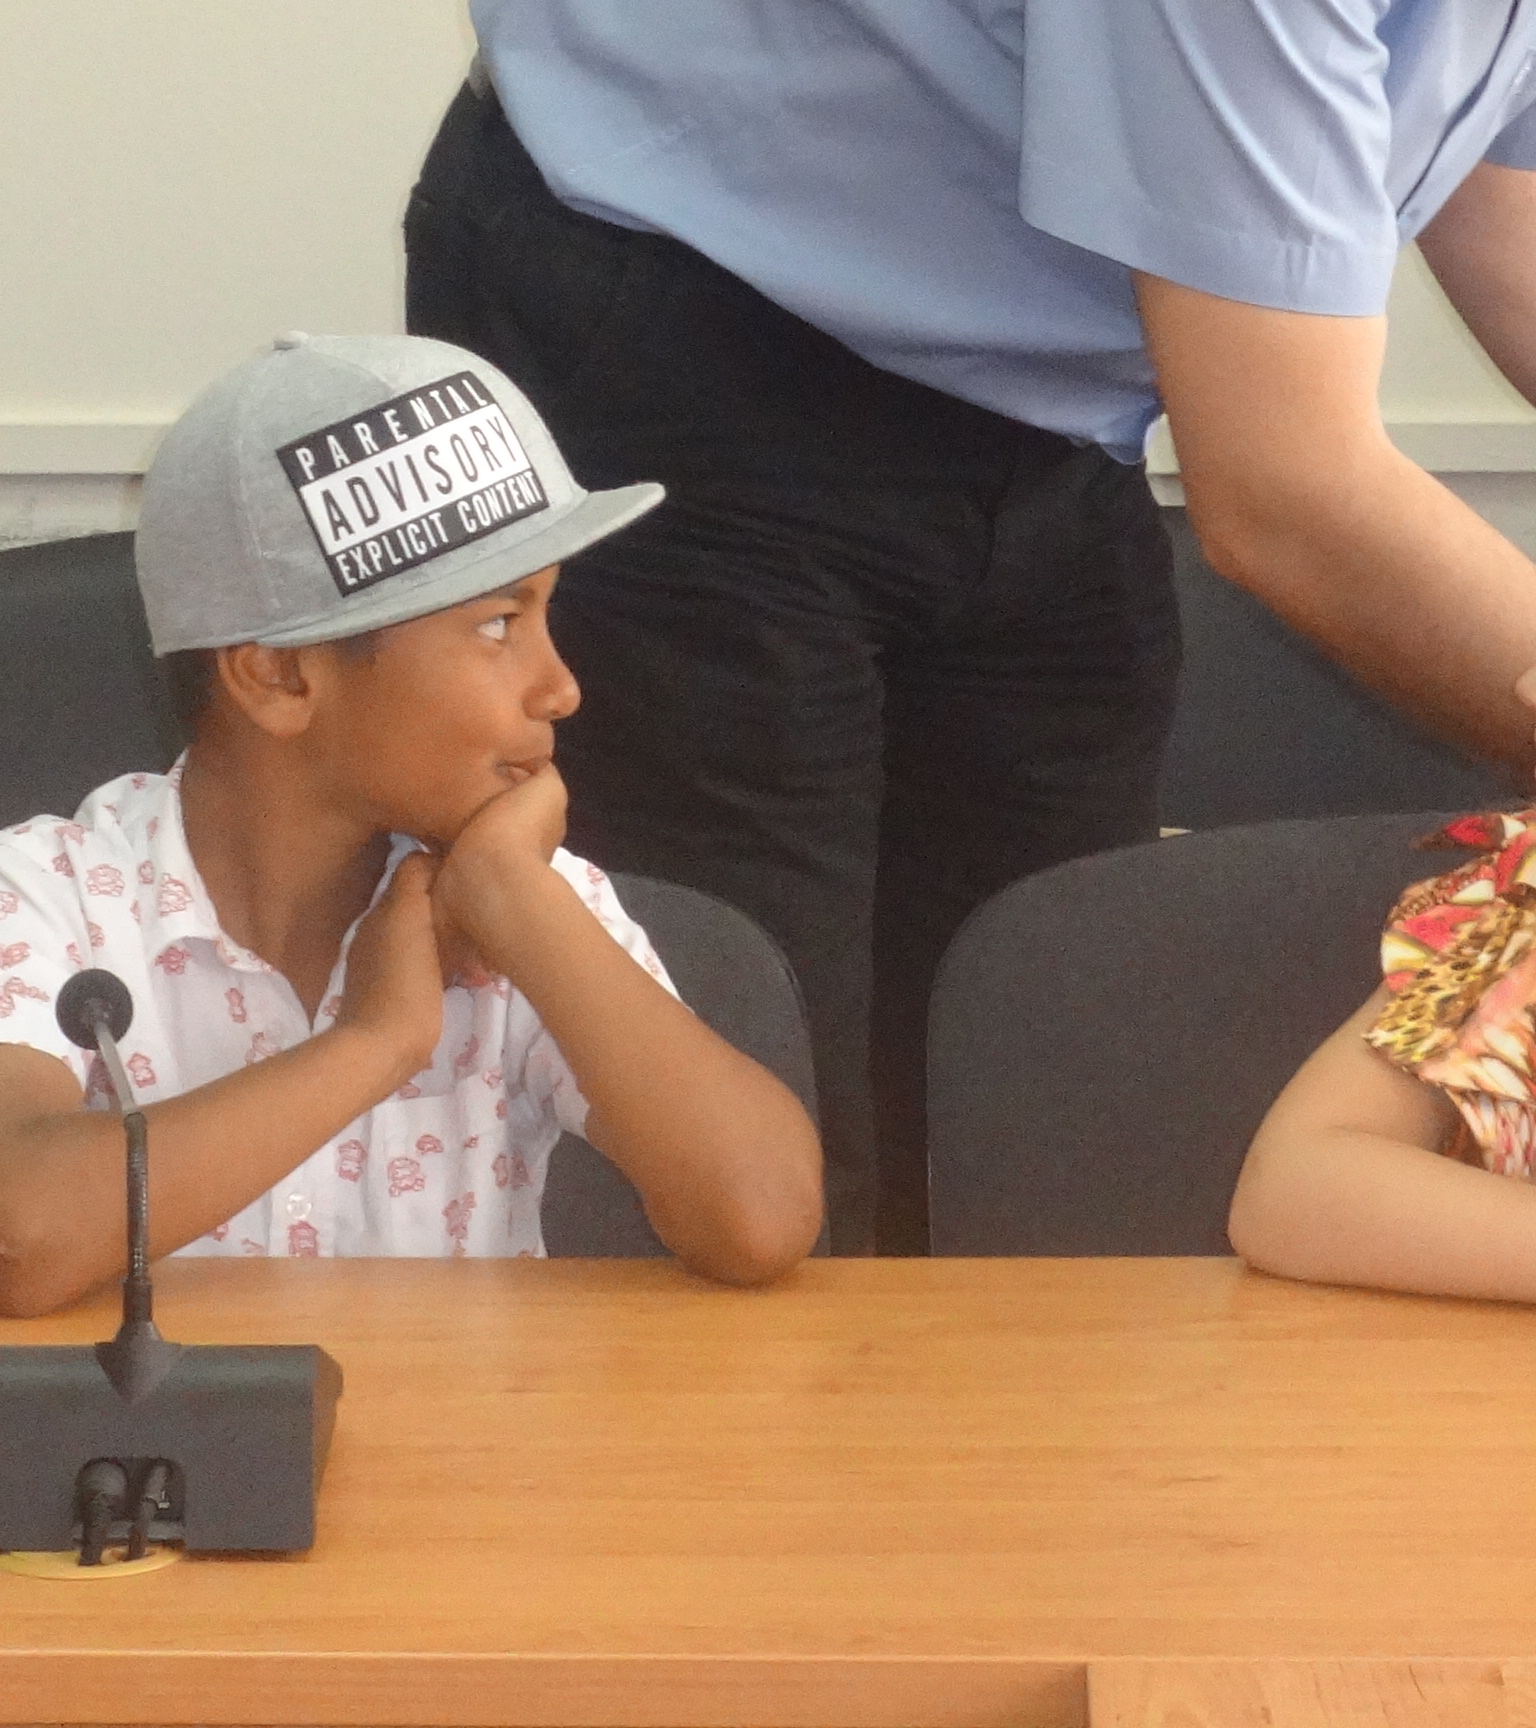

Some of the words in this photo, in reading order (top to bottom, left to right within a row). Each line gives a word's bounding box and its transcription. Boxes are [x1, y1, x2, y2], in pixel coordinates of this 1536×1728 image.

[295, 378, 490, 480] PARENTAL
[319, 415, 519, 542] ADVISORY
[335, 515, 450, 587] EXPLICIT
[456, 472, 543, 533] CONTENT
